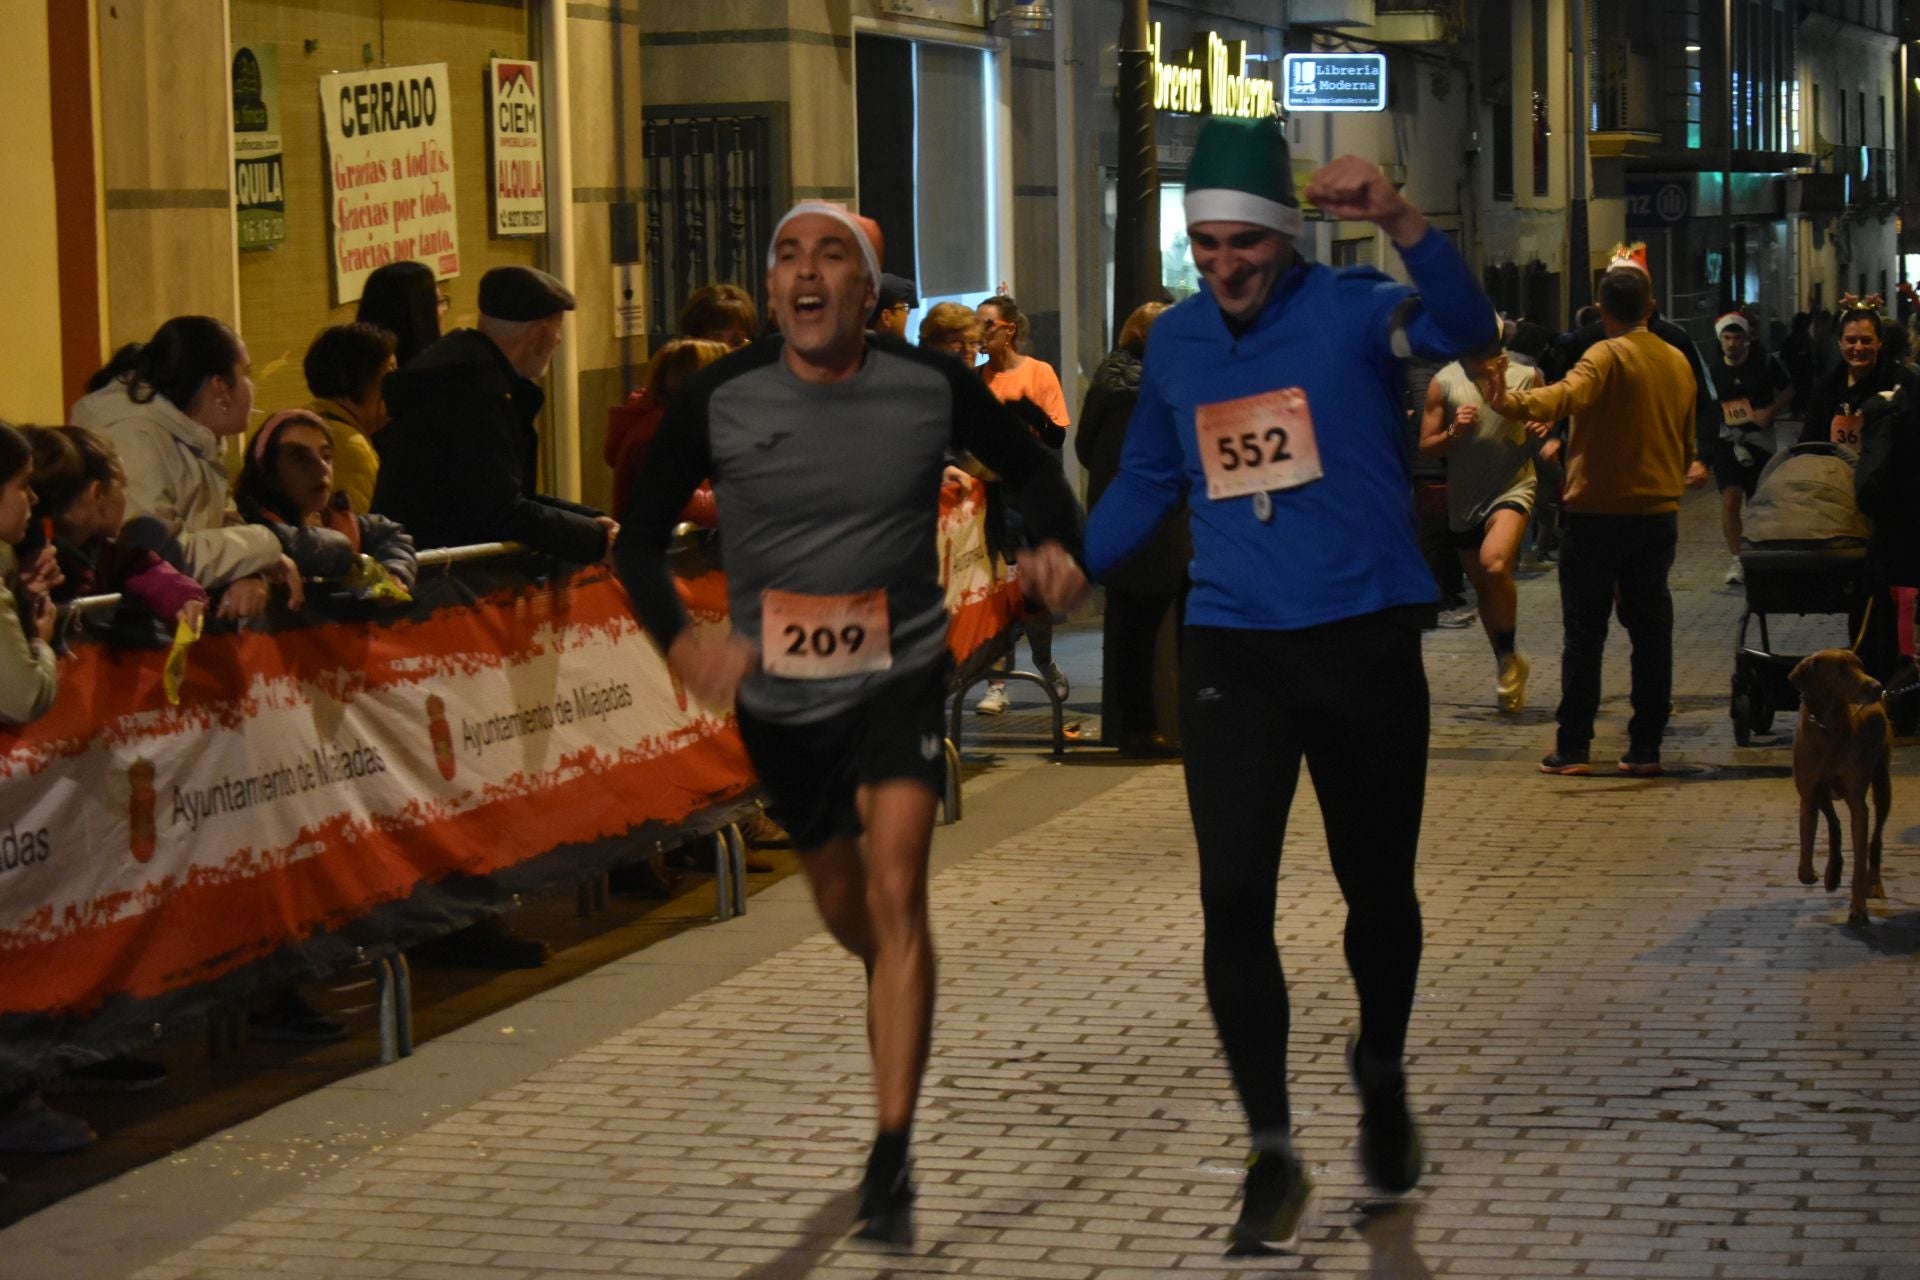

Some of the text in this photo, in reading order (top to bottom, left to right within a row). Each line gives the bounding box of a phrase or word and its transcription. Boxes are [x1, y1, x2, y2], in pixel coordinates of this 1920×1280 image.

[1316, 65, 1379, 75] Librería
[1319, 80, 1376, 90] Moderna
[340, 76, 437, 138] CERRADO
[499, 102, 537, 133] CIEM
[237, 162, 284, 206] QUILA
[335, 149, 387, 191] Gracias
[392, 158, 403, 180] a
[499, 159, 543, 199] ALQUILA
[338, 192, 389, 233] Gracias
[393, 197, 416, 234] por
[338, 232, 391, 274] Gracias
[394, 237, 416, 261] por
[1217, 426, 1292, 471] 552
[1837, 429, 1861, 444] 36
[783, 624, 865, 657] 209
[462, 678, 633, 756] Ayuntamiento de Miajadas
[297, 755, 317, 792] de
[0, 822, 49, 871] das
